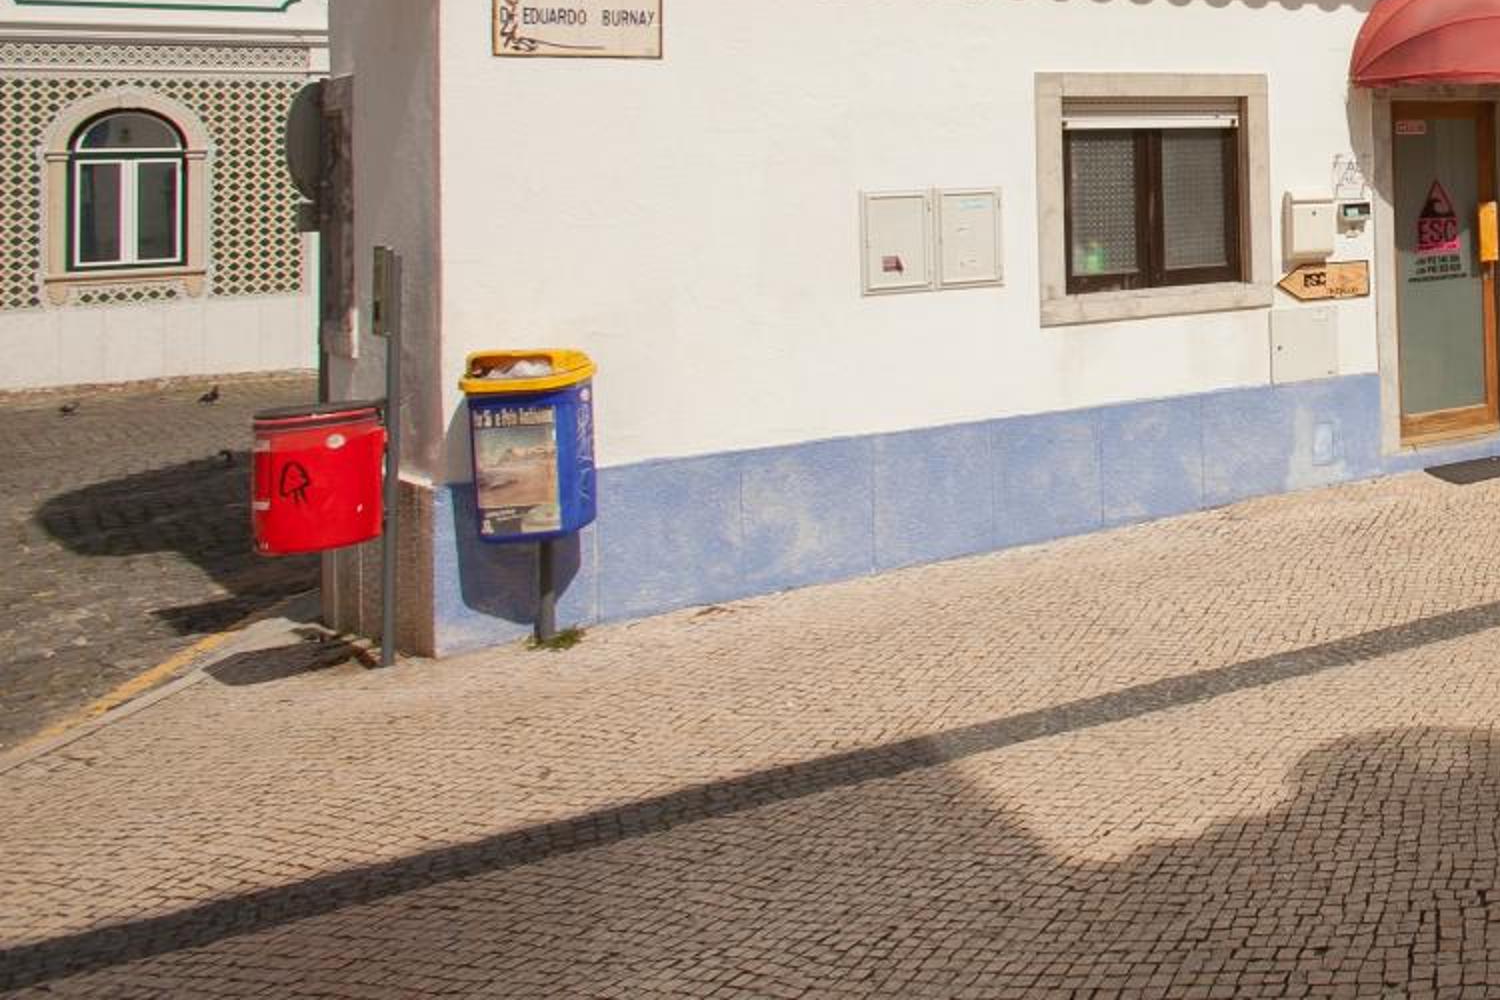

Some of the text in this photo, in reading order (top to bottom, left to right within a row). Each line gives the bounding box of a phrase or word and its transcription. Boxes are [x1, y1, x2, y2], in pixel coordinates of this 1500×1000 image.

[523, 7, 587, 25] EDUARDO
[602, 9, 655, 27] BURNAY
[1418, 218, 1457, 244] ESC
[1303, 272, 1326, 288] ESC
